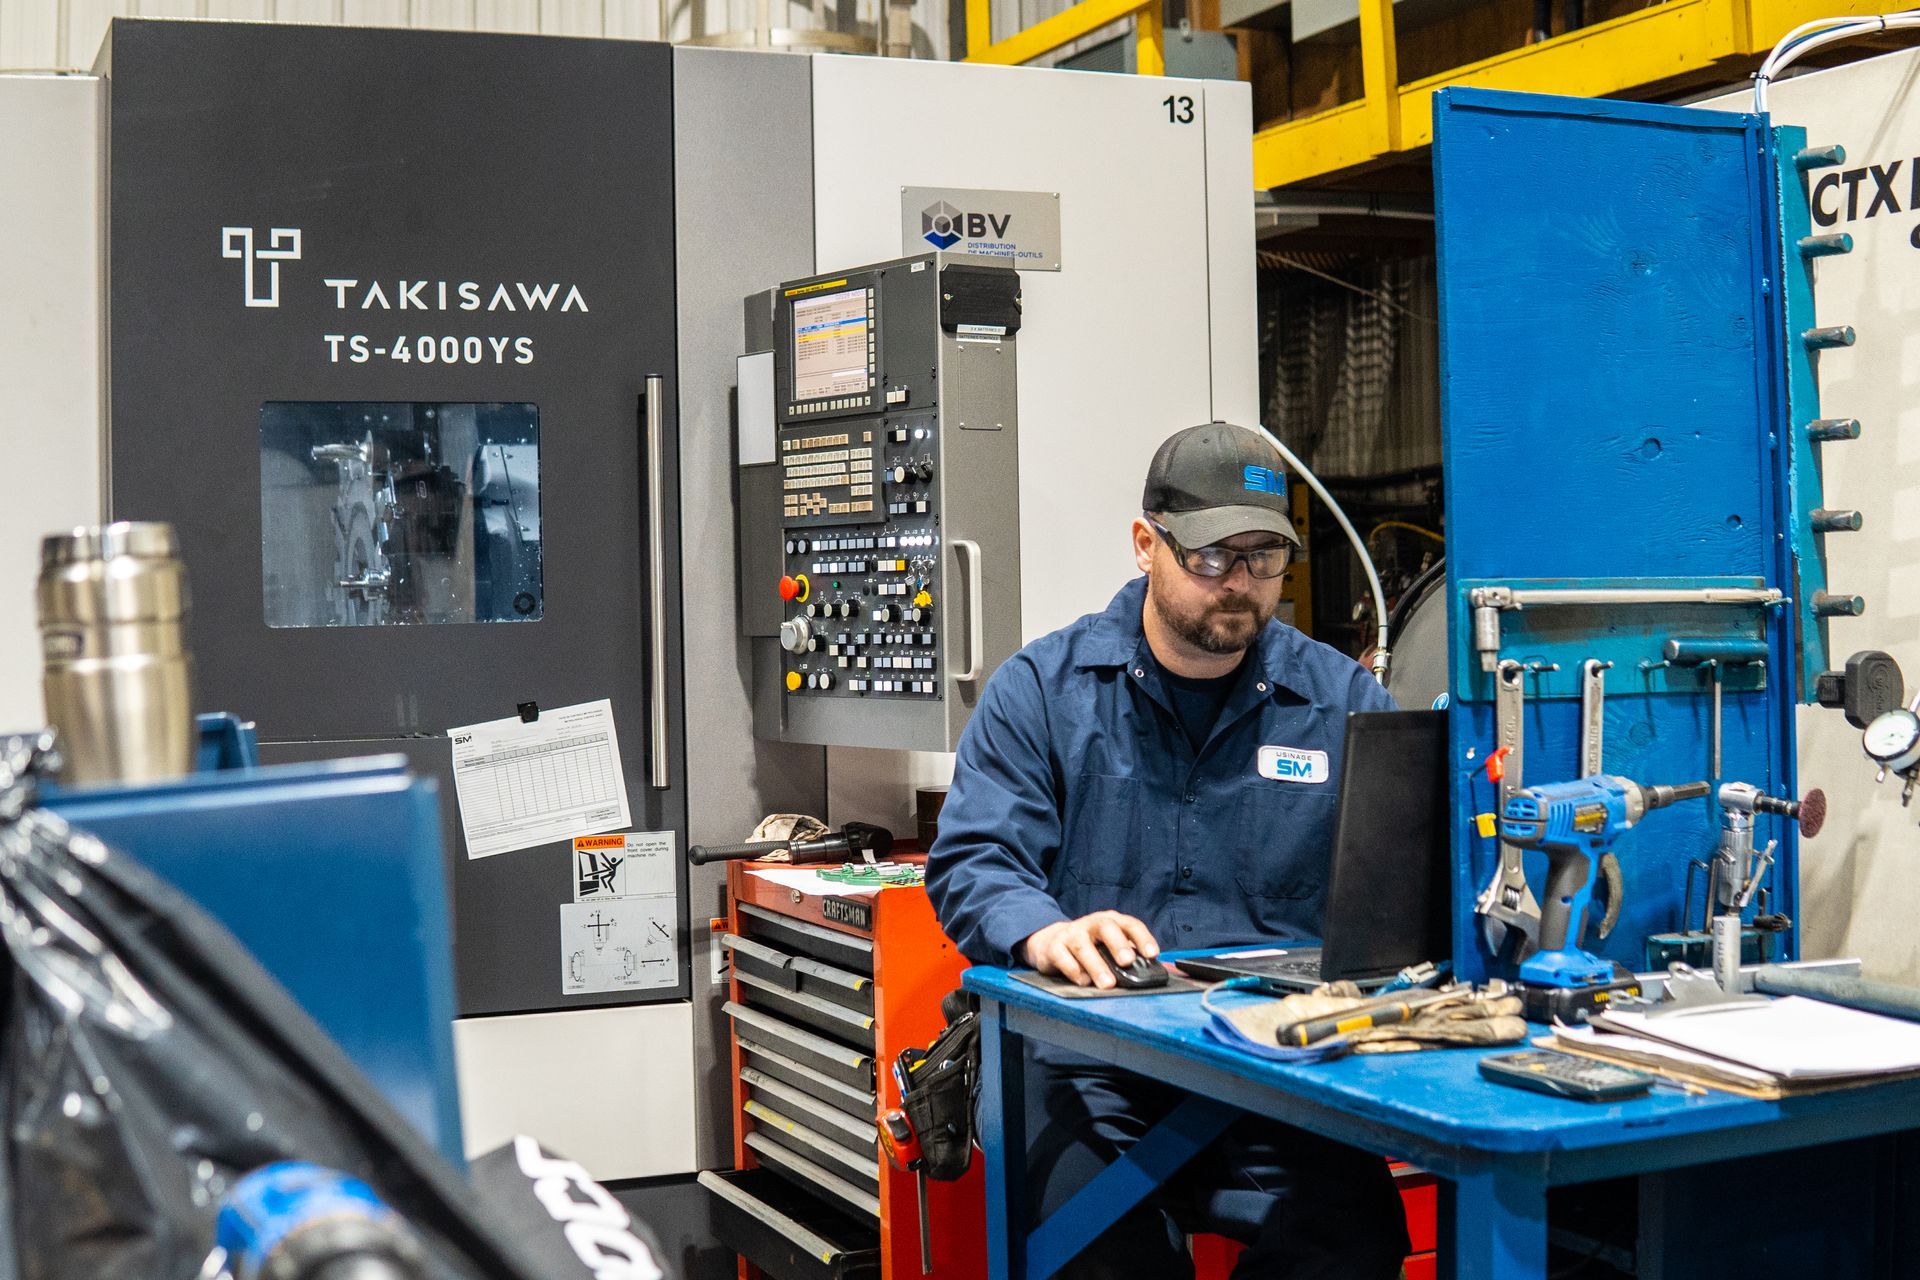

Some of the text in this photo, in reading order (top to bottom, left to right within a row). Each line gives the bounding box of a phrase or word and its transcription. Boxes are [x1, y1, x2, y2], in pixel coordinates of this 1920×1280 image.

[1163, 95, 1194, 124] 13
[1811, 160, 1904, 227] CTX
[967, 212, 1011, 239] BV
[967, 242, 1016, 250] DISTRIBUTION
[323, 278, 589, 312] TAKISAWA
[324, 334, 534, 364] TS-4000YS
[1243, 464, 1286, 497] SM
[454, 735, 472, 745] SM
[1276, 751, 1312, 761] USINAGE
[1276, 759, 1312, 777] SM
[585, 837, 623, 846] WARNING
[823, 899, 866, 928] CRAFTSMAN
